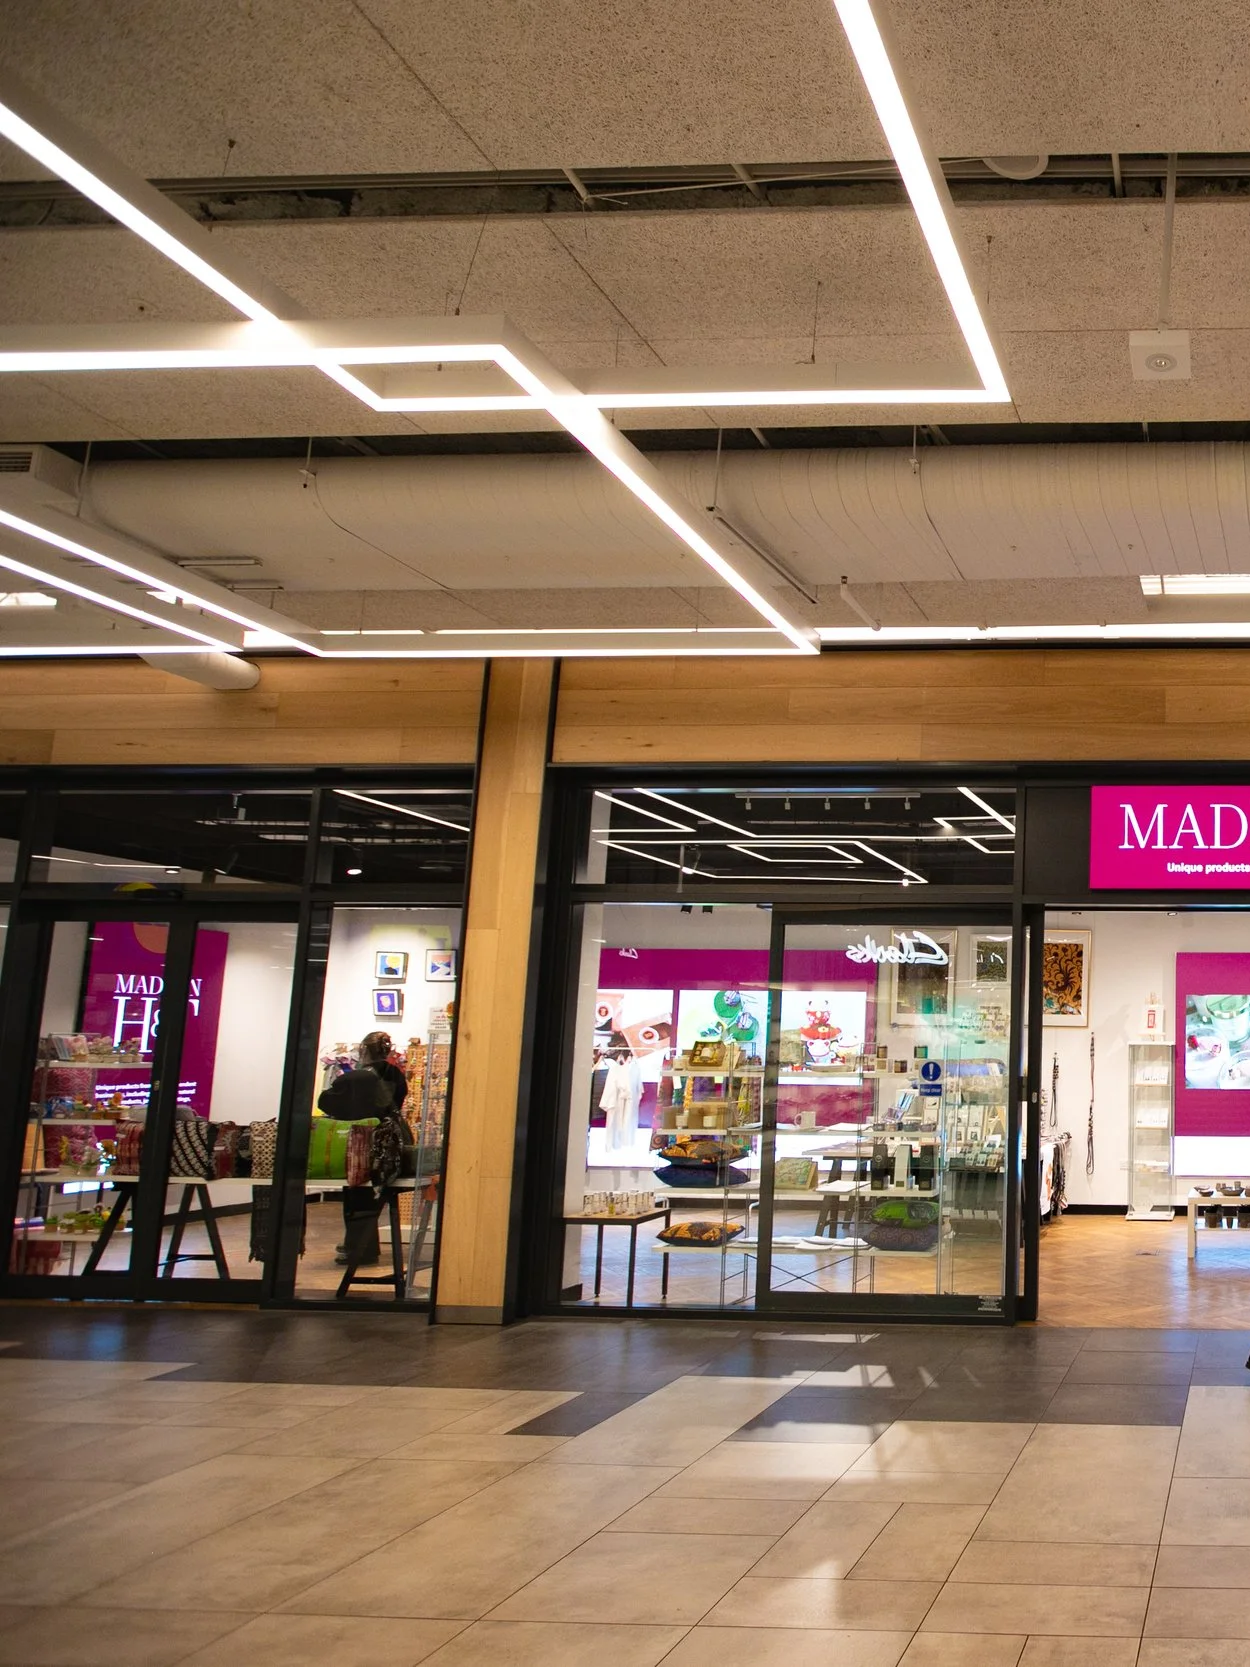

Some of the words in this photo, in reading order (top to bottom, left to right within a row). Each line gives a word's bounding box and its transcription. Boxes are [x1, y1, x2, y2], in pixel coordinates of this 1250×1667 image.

[1167, 862, 1203, 874] Unique
[1205, 862, 1250, 874] products
[114, 974, 165, 994] MAD
